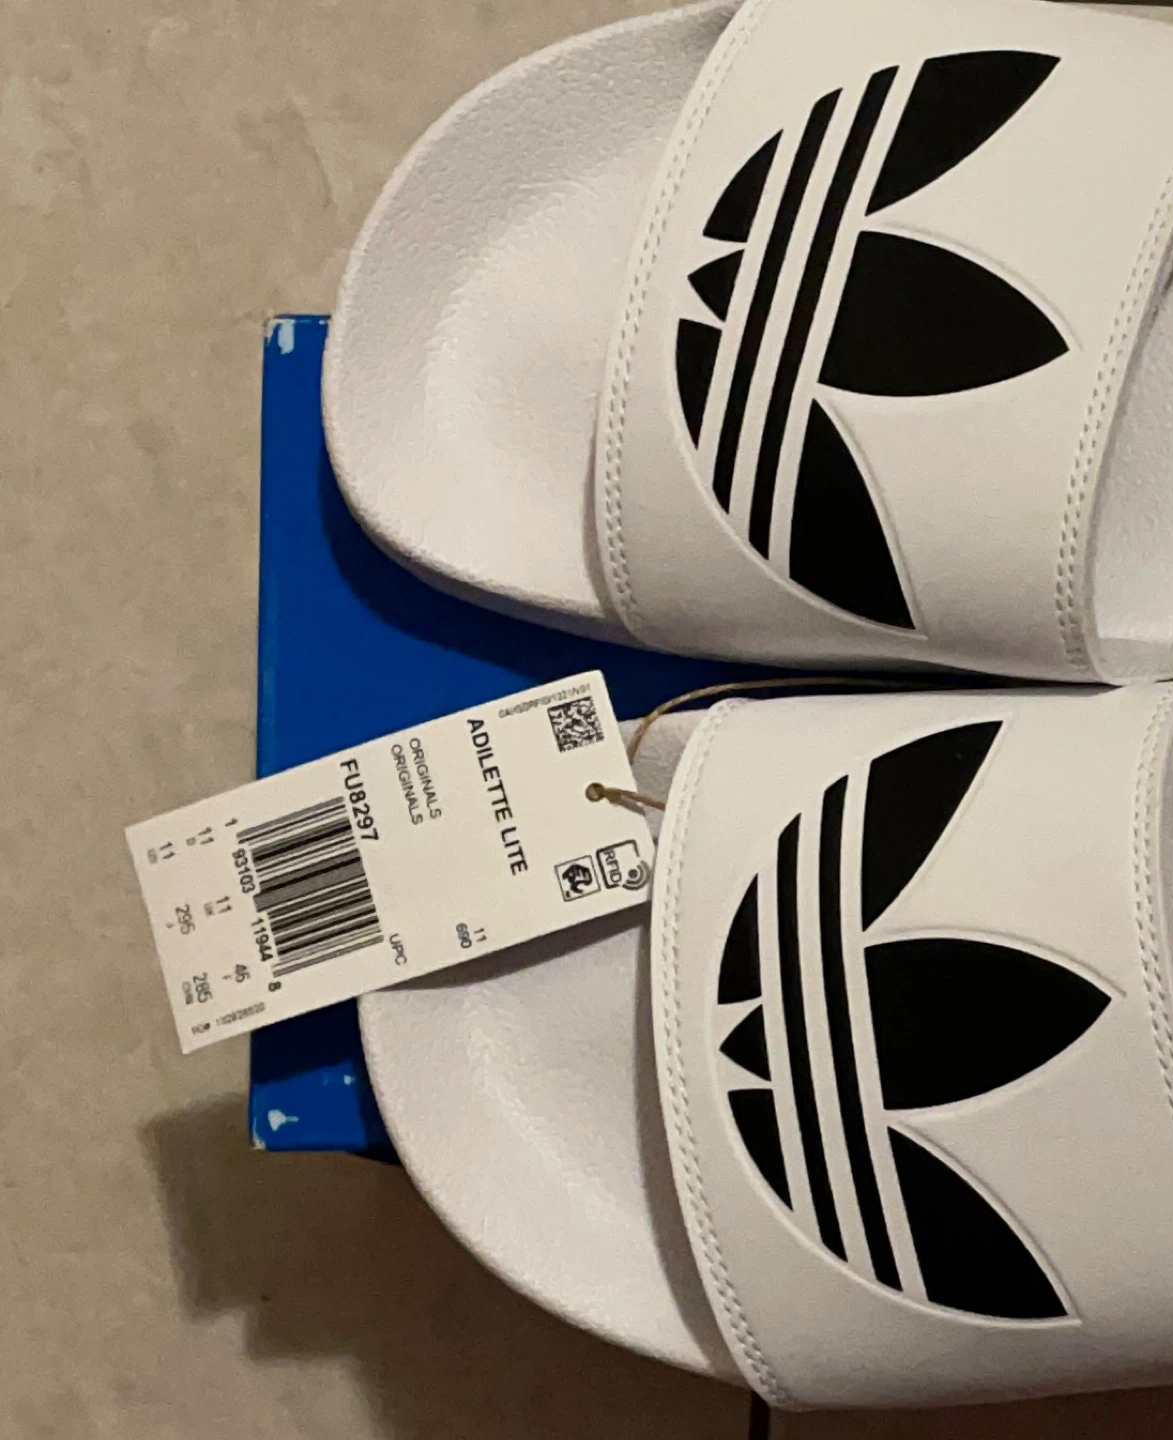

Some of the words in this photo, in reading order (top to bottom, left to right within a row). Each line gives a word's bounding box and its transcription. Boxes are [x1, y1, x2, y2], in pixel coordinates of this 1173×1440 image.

[340, 758, 379, 841] FU8297
[391, 744, 423, 825] ORIGINALS
[409, 738, 441, 819] ORIGINALS
[467, 719, 513, 822] ADILETTE
[500, 826, 528, 876] LITE
[159, 841, 175, 859] 11
[198, 826, 214, 845] 11
[216, 896, 232, 914] 11
[602, 849, 622, 884] RFID
[232, 848, 256, 894] 93103
[251, 918, 273, 962] 11944
[268, 981, 282, 992] 8
[389, 933, 407, 965] UPC
[473, 928, 487, 943] 11
